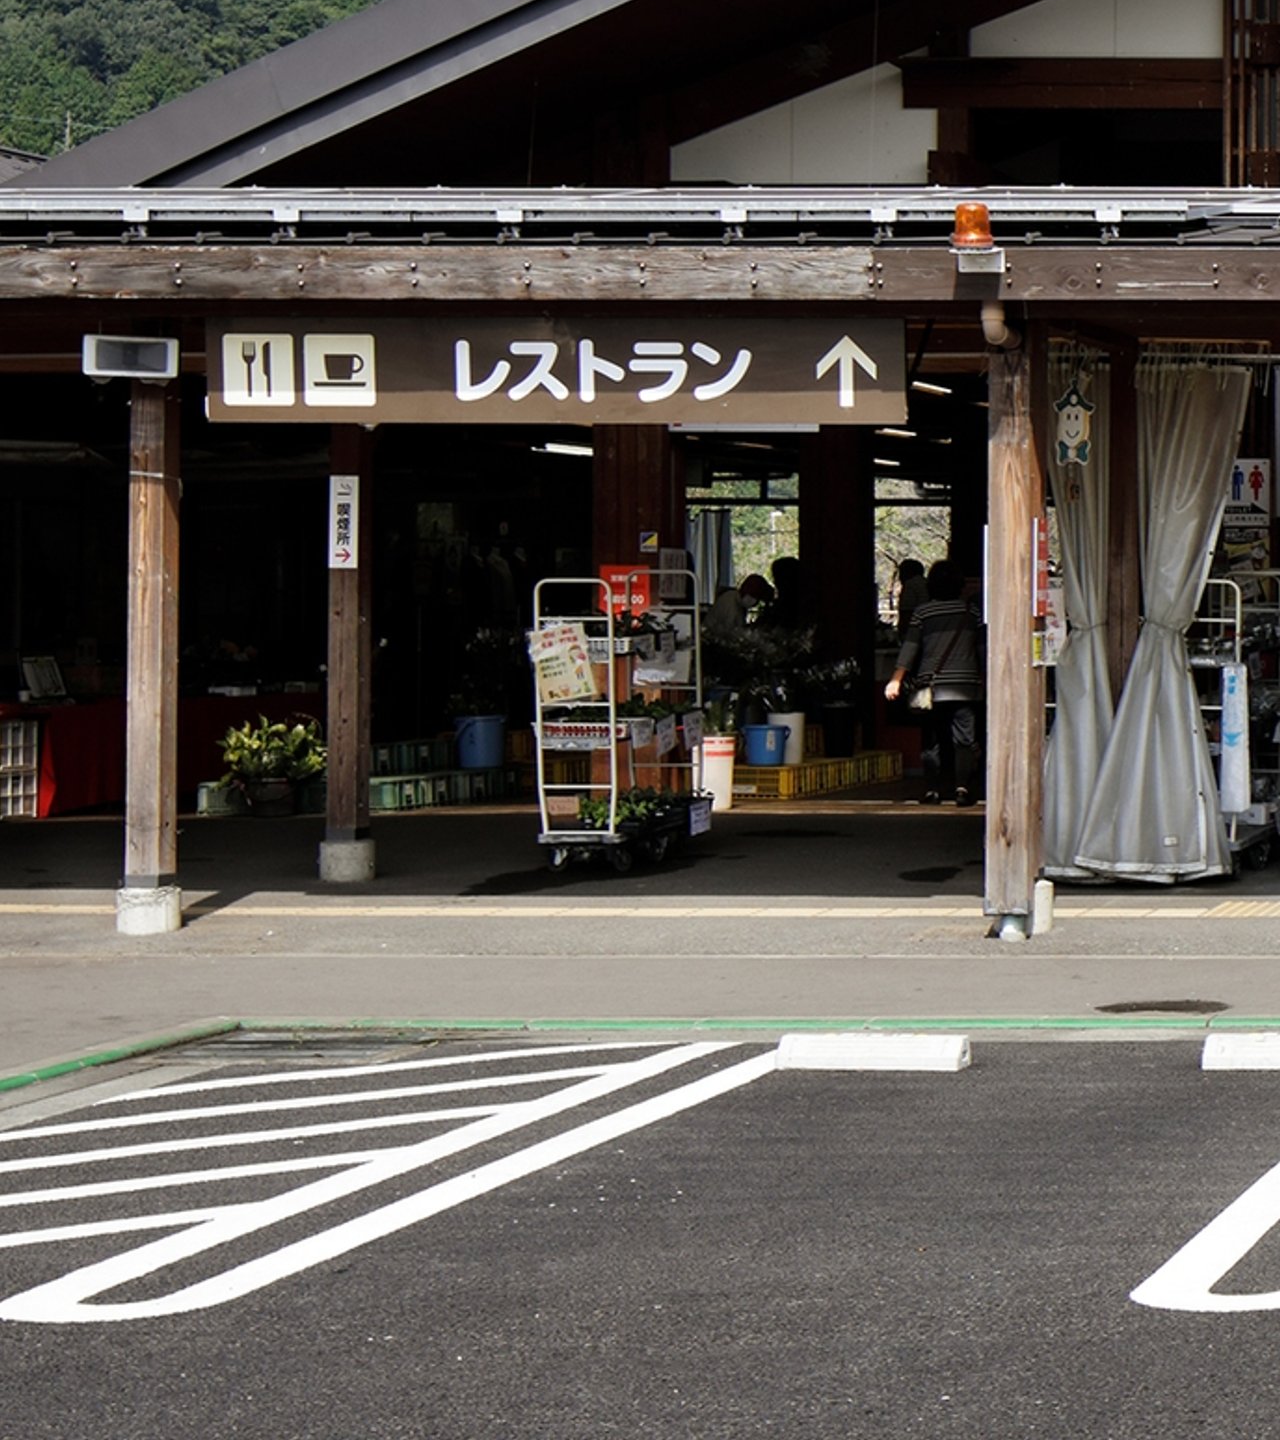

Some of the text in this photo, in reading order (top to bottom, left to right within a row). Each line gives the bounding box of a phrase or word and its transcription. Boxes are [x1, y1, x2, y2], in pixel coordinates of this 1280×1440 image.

[455, 339, 752, 403] レストラン
[336, 502, 351, 546] 喫煙所
